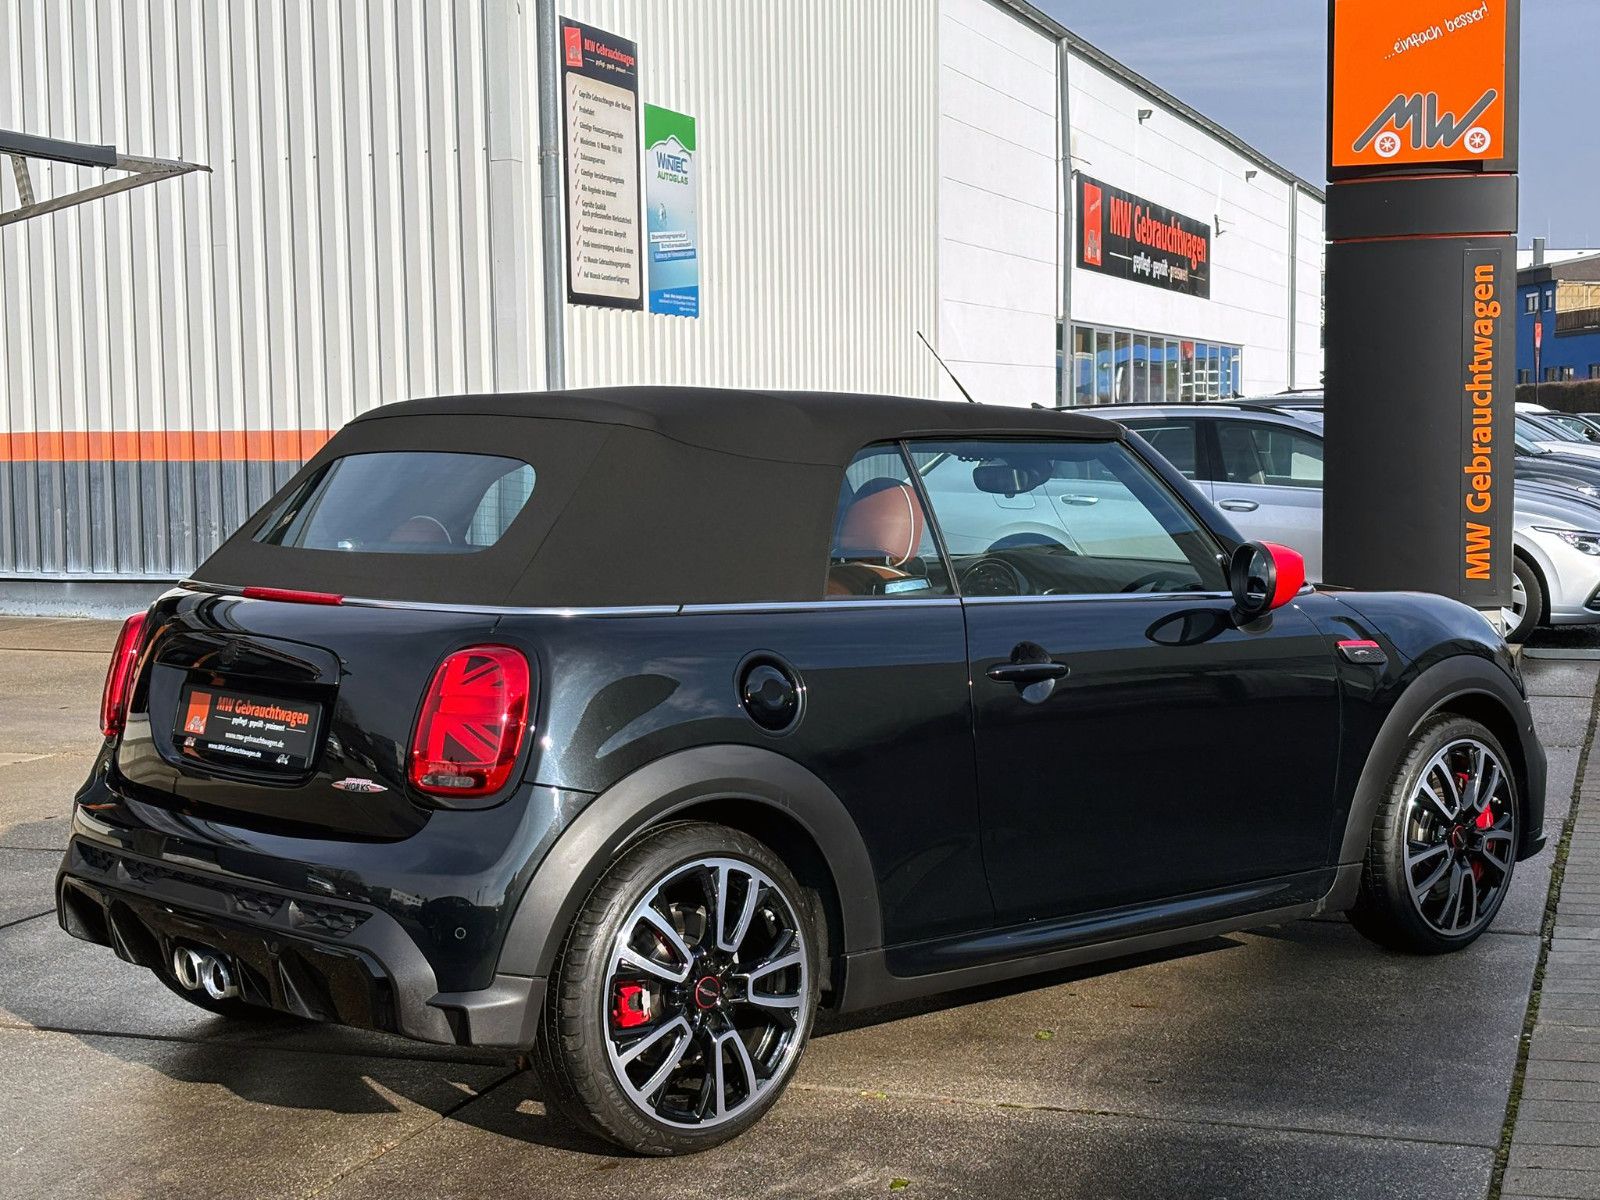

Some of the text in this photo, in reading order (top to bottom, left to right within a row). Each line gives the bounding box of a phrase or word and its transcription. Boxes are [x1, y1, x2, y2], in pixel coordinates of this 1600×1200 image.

[1444, 3, 1490, 33] besser!
[584, 38, 596, 52] MW
[596, 43, 635, 67] Gebrauchtwagen
[1352, 88, 1498, 152] MW
[657, 171, 688, 185] AUTOGLAS
[1110, 196, 1132, 239] MW
[1134, 205, 1206, 271] Gebrauchtwagen
[1464, 263, 1501, 580] MW Gebrauchtwagen
[216, 696, 310, 727] MW Gebrauchtwagen
[345, 782, 370, 791] WORKS
